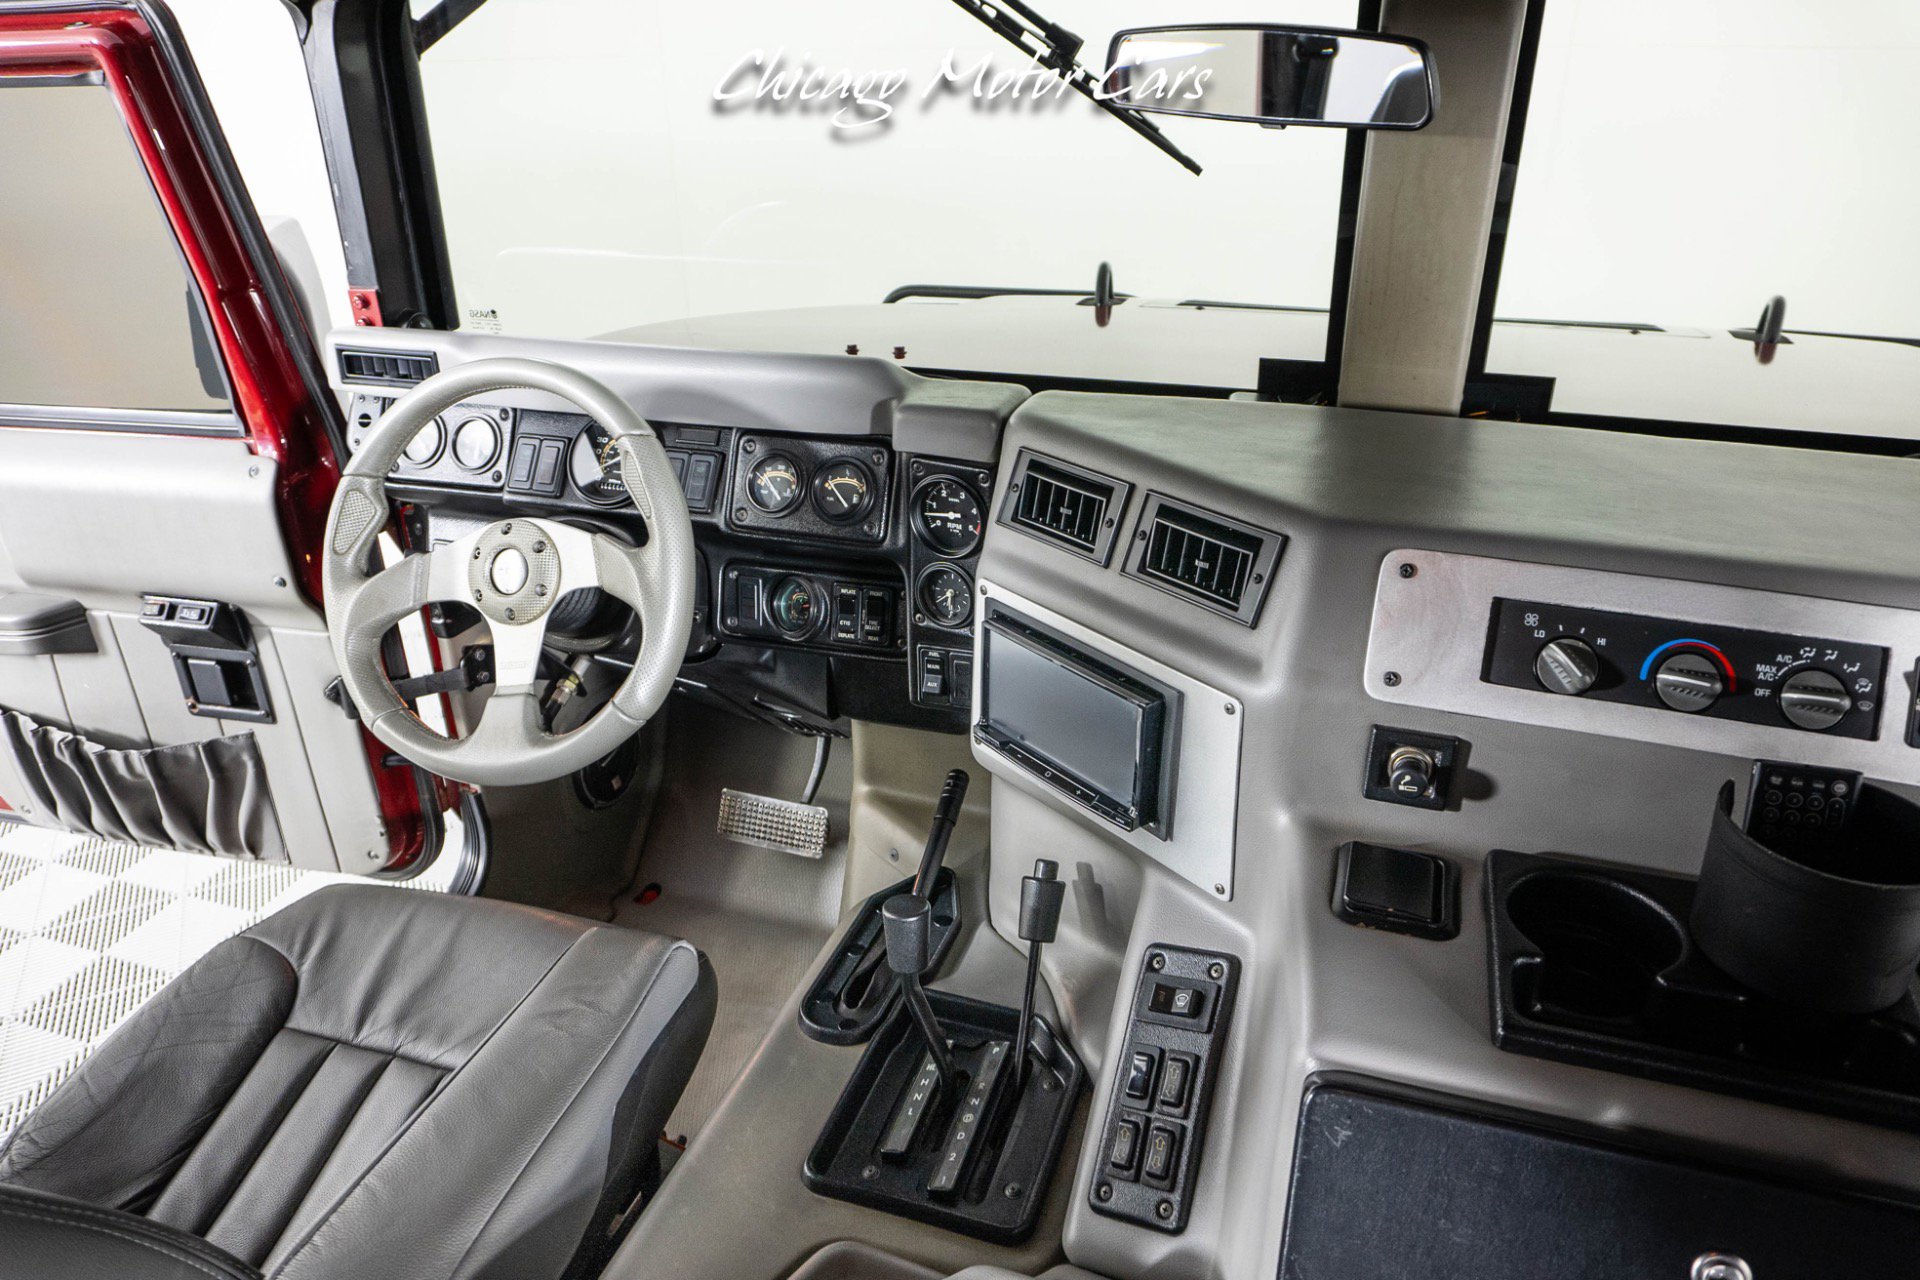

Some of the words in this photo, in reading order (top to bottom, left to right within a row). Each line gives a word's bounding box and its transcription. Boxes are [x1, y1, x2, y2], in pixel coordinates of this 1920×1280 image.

[947, 522, 962, 530] RPM
[1534, 629, 1546, 638] LO
[1597, 637, 1607, 646] HI
[1776, 654, 1793, 664] A/C
[1756, 663, 1778, 674] MAX
[1757, 672, 1775, 682] A/C
[1754, 687, 1772, 698] OFF
[992, 1046, 1000, 1055] P
[920, 1078, 930, 1087] H
[913, 1092, 923, 1101] N
[970, 1097, 980, 1106] N
[908, 1107, 913, 1116] L
[956, 1131, 966, 1140] D
[948, 1152, 957, 1161] 2
